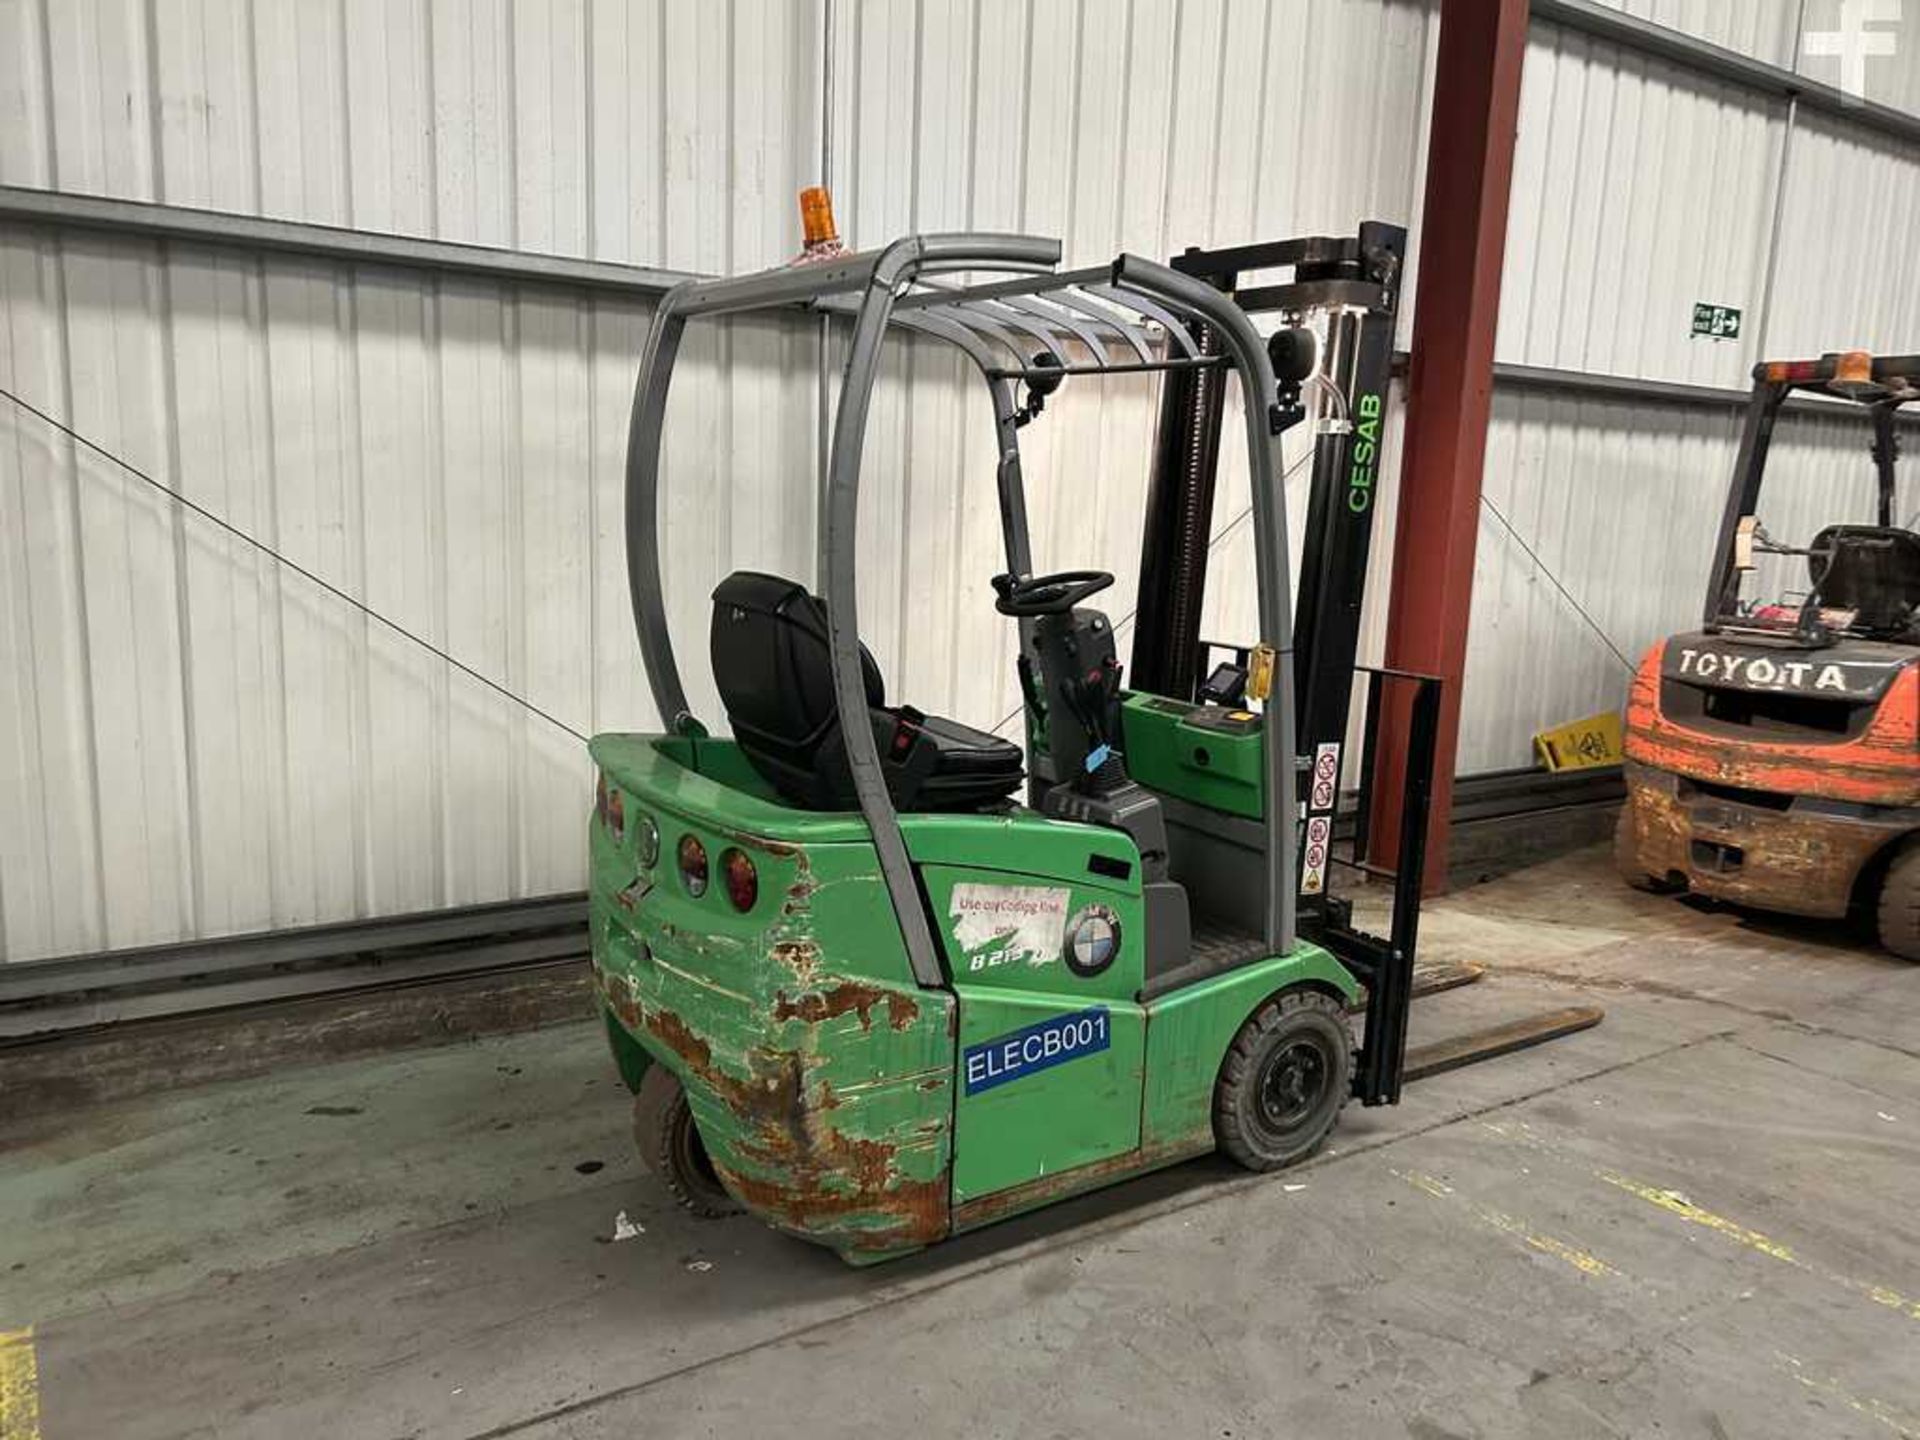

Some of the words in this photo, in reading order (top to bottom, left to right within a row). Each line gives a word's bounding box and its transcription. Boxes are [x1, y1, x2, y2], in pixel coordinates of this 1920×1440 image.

[1349, 394, 1381, 513] CESAB
[1679, 649, 1847, 691] TOYOTA
[967, 1015, 1105, 1083] ELECB001
